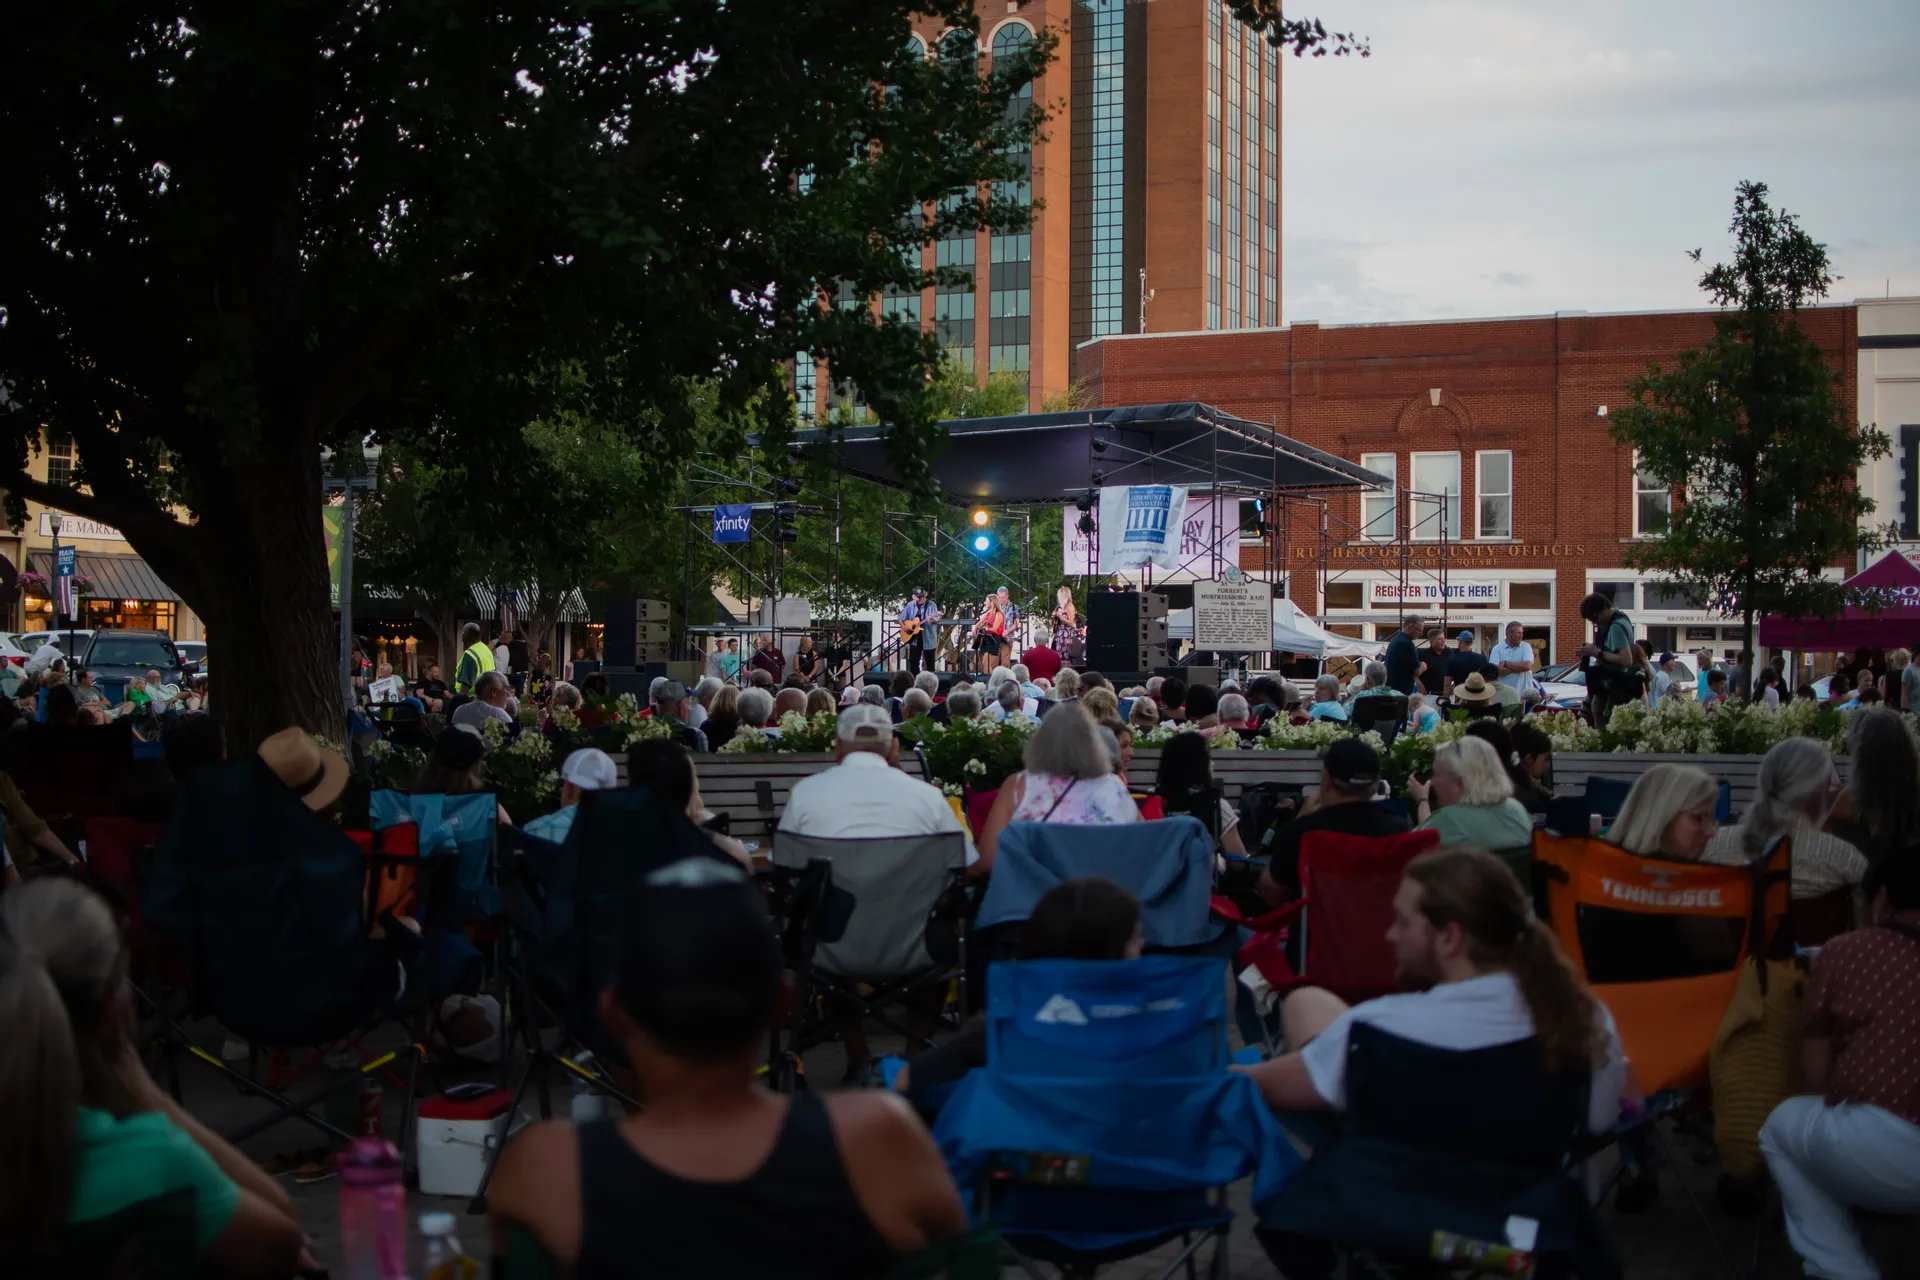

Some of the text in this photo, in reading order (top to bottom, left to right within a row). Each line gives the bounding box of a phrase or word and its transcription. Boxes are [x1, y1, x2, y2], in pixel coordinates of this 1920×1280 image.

[60, 521, 119, 535] HE MARKE
[715, 515, 750, 533] xfinity
[59, 549, 75, 557] MAIN
[1296, 544, 1586, 558] RUHERFORD COUNTY OFFICES
[1412, 559, 1443, 567] PUBL
[1375, 585, 1498, 597] REGISTER TO VOTE HERE!
[1602, 878, 1724, 907] TENNESSEE
